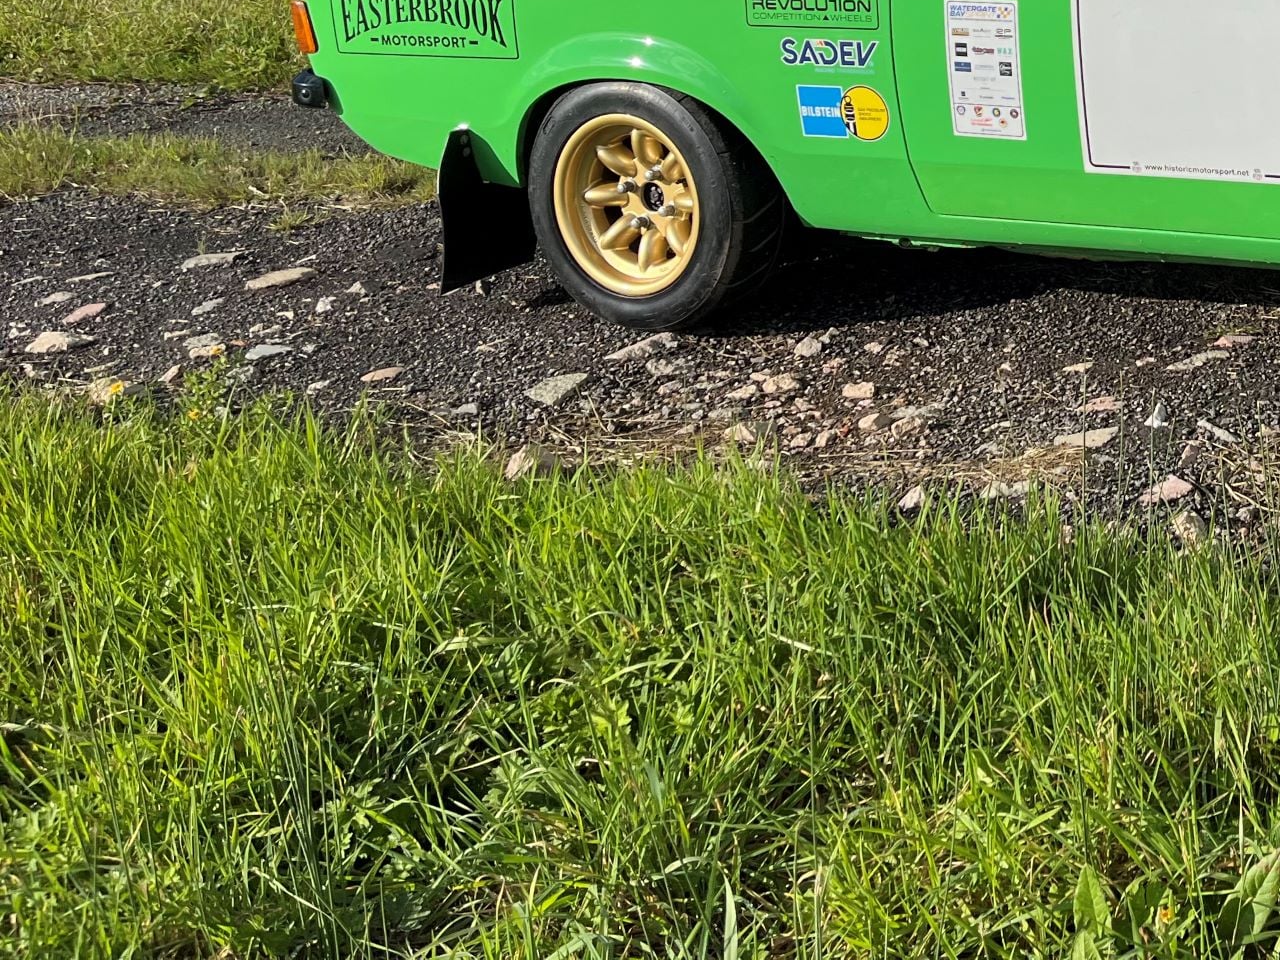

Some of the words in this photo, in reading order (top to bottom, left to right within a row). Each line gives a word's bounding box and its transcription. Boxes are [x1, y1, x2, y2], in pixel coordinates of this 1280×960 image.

[949, 4, 997, 13] WATERGATE
[752, 12, 821, 21] COMPETITION
[831, 14, 873, 23] WHEELS
[381, 34, 467, 49] MOTORSPORT
[781, 37, 877, 67] SADEV
[801, 104, 840, 119] BILSTEIN
